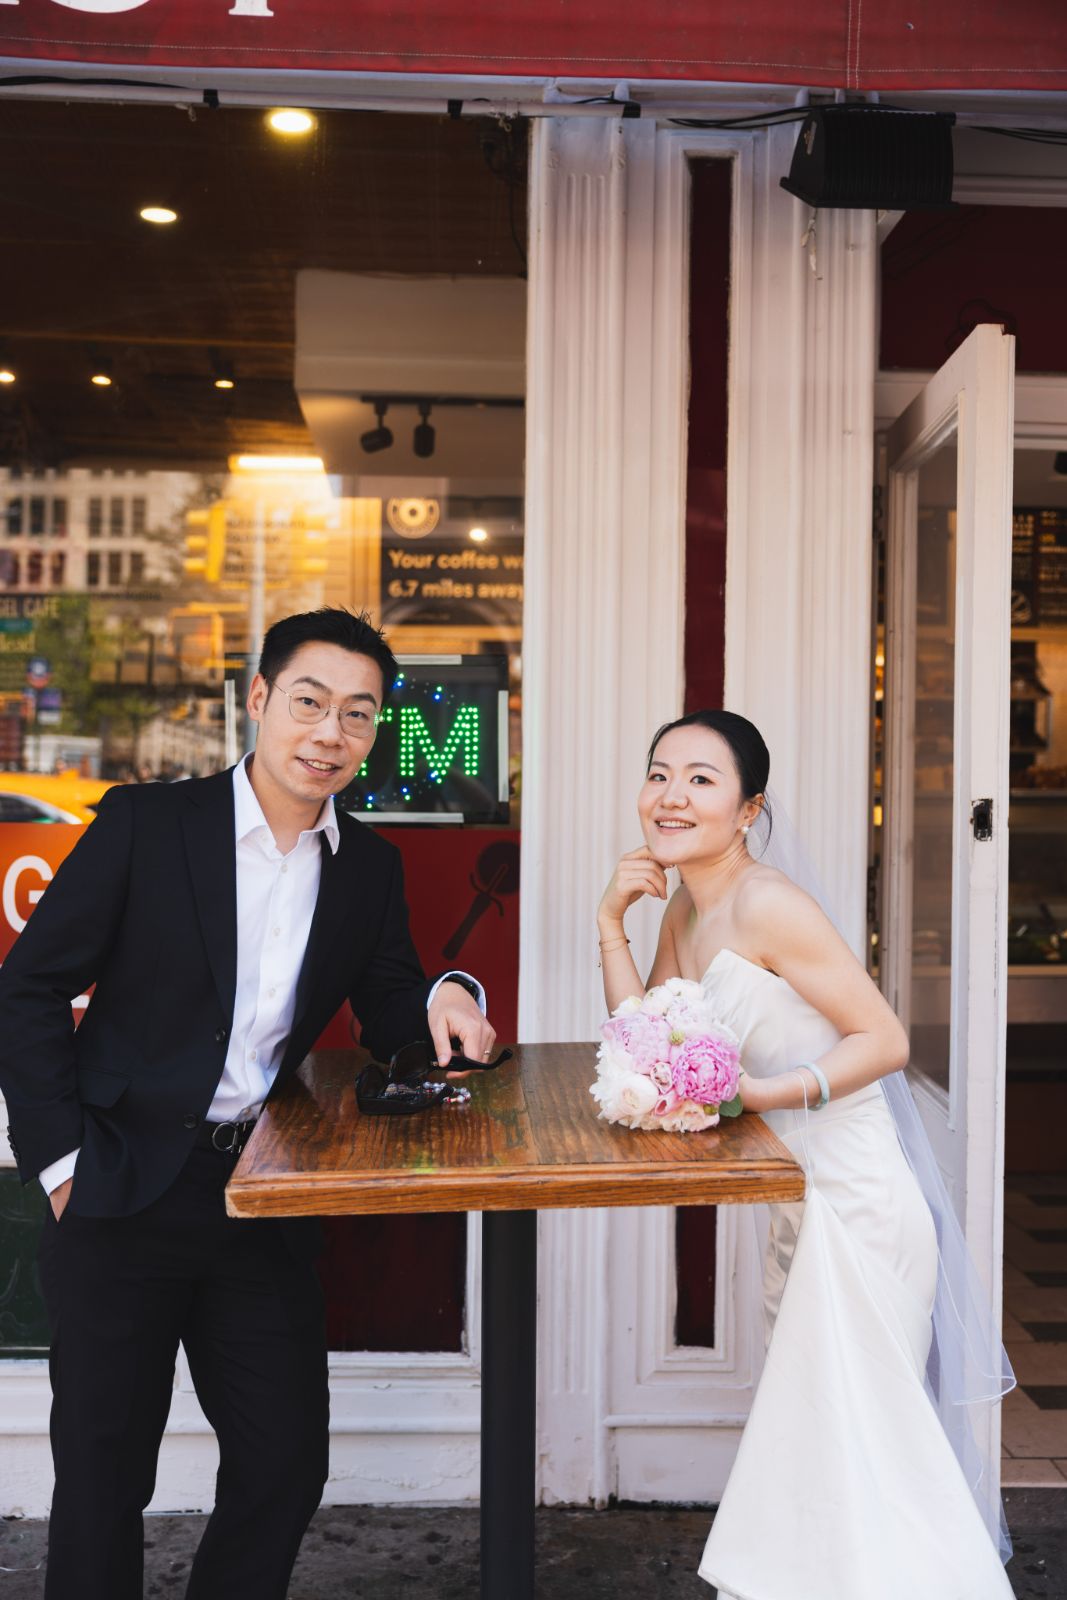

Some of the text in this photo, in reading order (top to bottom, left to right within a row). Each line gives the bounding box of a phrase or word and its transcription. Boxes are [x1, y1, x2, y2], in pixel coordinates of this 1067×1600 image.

[388, 549, 434, 569] Your
[437, 550, 499, 569] coffee
[388, 579, 419, 598] 6.7
[421, 578, 475, 598] miles
